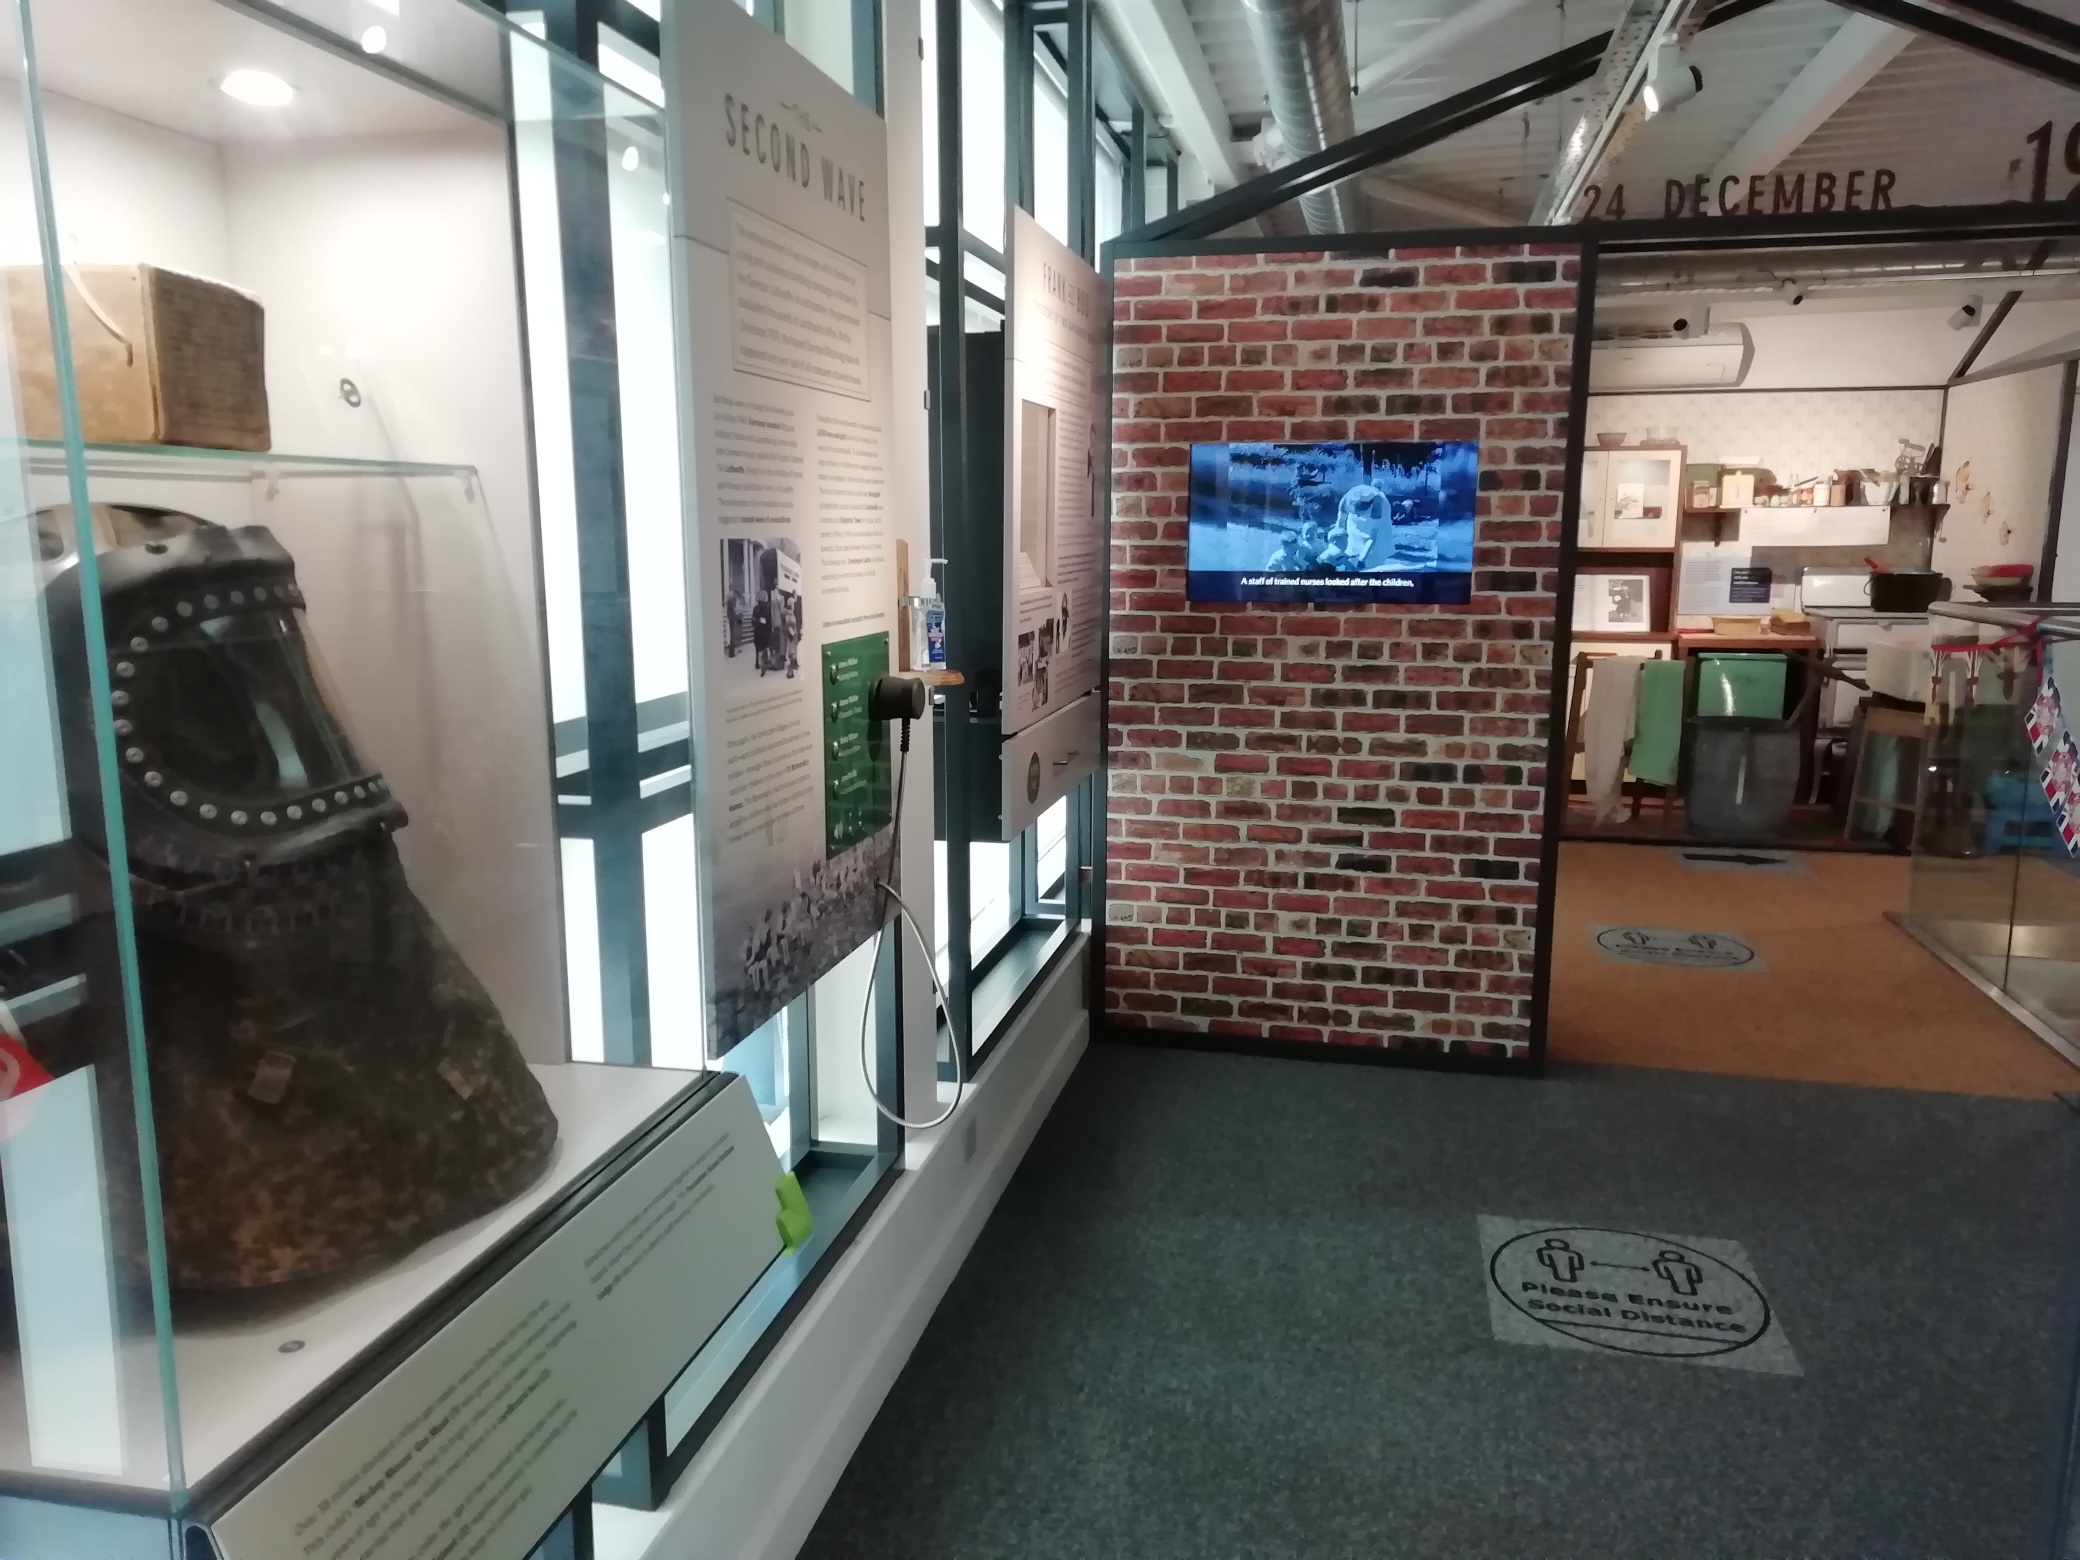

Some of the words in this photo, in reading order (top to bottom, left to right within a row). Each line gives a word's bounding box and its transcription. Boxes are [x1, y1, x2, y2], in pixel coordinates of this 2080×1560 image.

[724, 93, 810, 188] SECOND
[821, 156, 866, 222] WAVE
[1584, 183, 1626, 220] 24
[1664, 169, 1897, 220] DECEMBER
[1248, 577, 1266, 585] staff
[1274, 577, 1300, 586] trained
[1300, 578, 1325, 586] nurses
[1325, 577, 1350, 586] looked
[1350, 577, 1368, 586] after
[1369, 577, 1381, 586] the
[1521, 1281, 1618, 1304] Please
[1627, 1294, 1734, 1315] Ensure
[1527, 1299, 1611, 1318] Social
[1621, 1309, 1747, 1334] Distance
